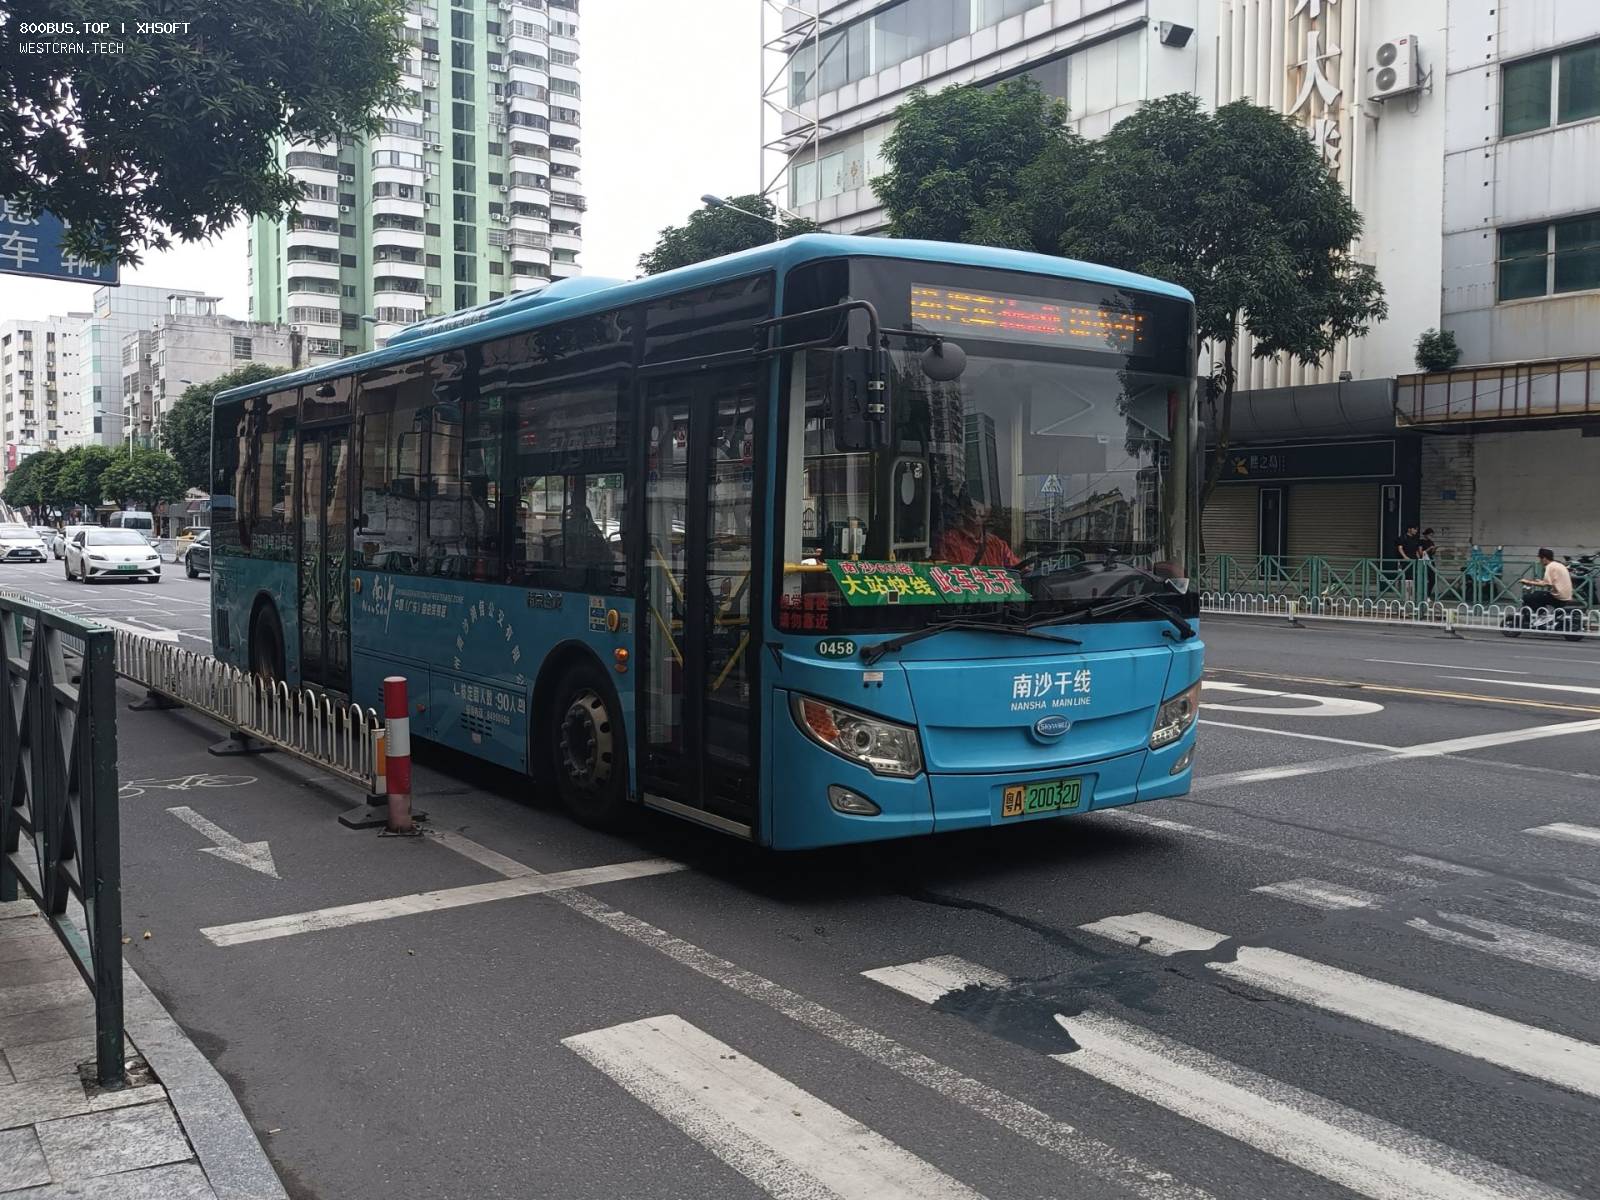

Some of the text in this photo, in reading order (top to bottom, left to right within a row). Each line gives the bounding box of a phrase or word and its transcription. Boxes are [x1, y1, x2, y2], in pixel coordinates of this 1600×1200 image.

[841, 575, 937, 596] 大站快线
[929, 566, 1021, 595] 此车先开
[819, 641, 854, 655] 0458
[1012, 669, 1091, 699] 南沙干线
[1010, 700, 1047, 712] NANSHA
